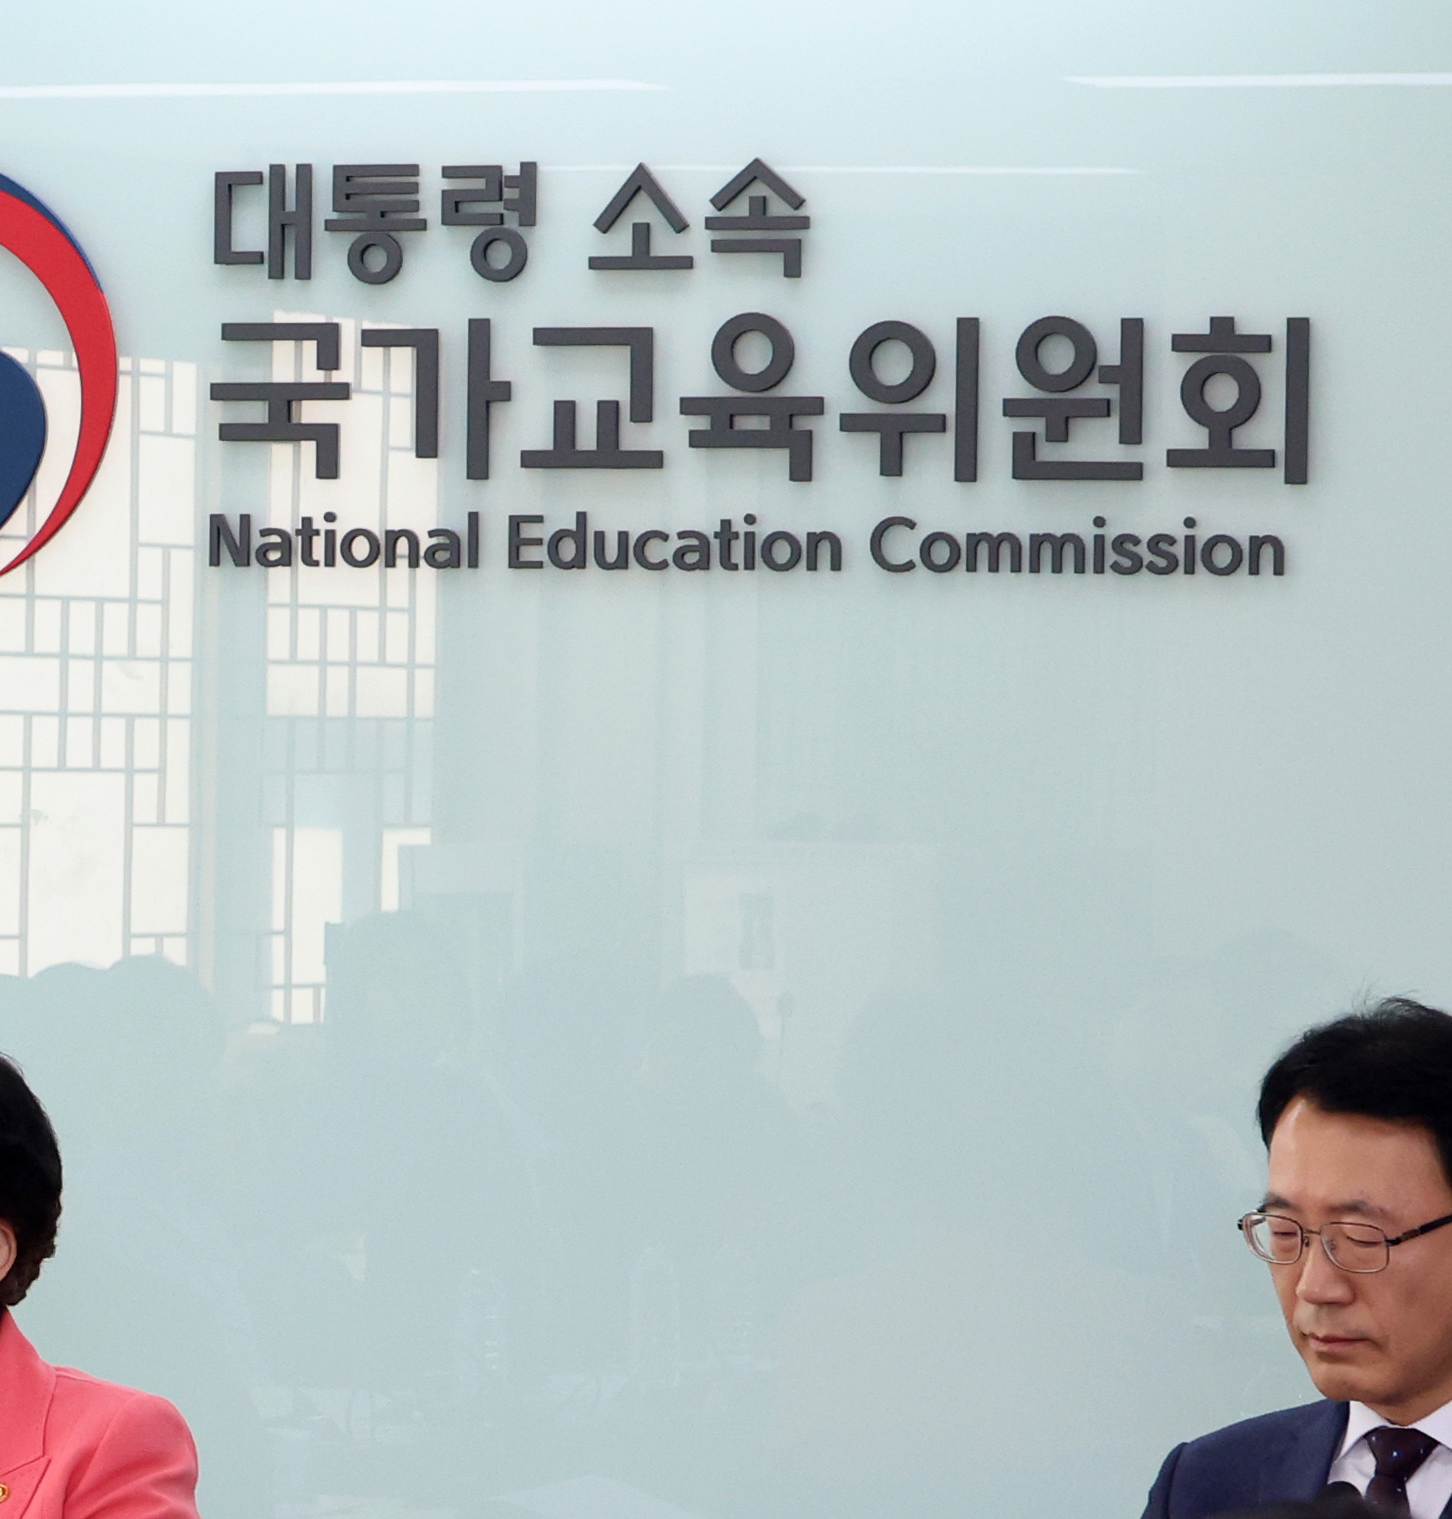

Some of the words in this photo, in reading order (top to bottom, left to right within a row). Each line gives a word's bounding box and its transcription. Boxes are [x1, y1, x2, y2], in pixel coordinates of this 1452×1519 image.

[213, 159, 538, 285] 대통령
[588, 156, 812, 279] 소속
[209, 312, 1312, 486] 국가교육위원회
[208, 512, 480, 571] National
[507, 512, 843, 574] Education
[869, 517, 1286, 578] Commission
